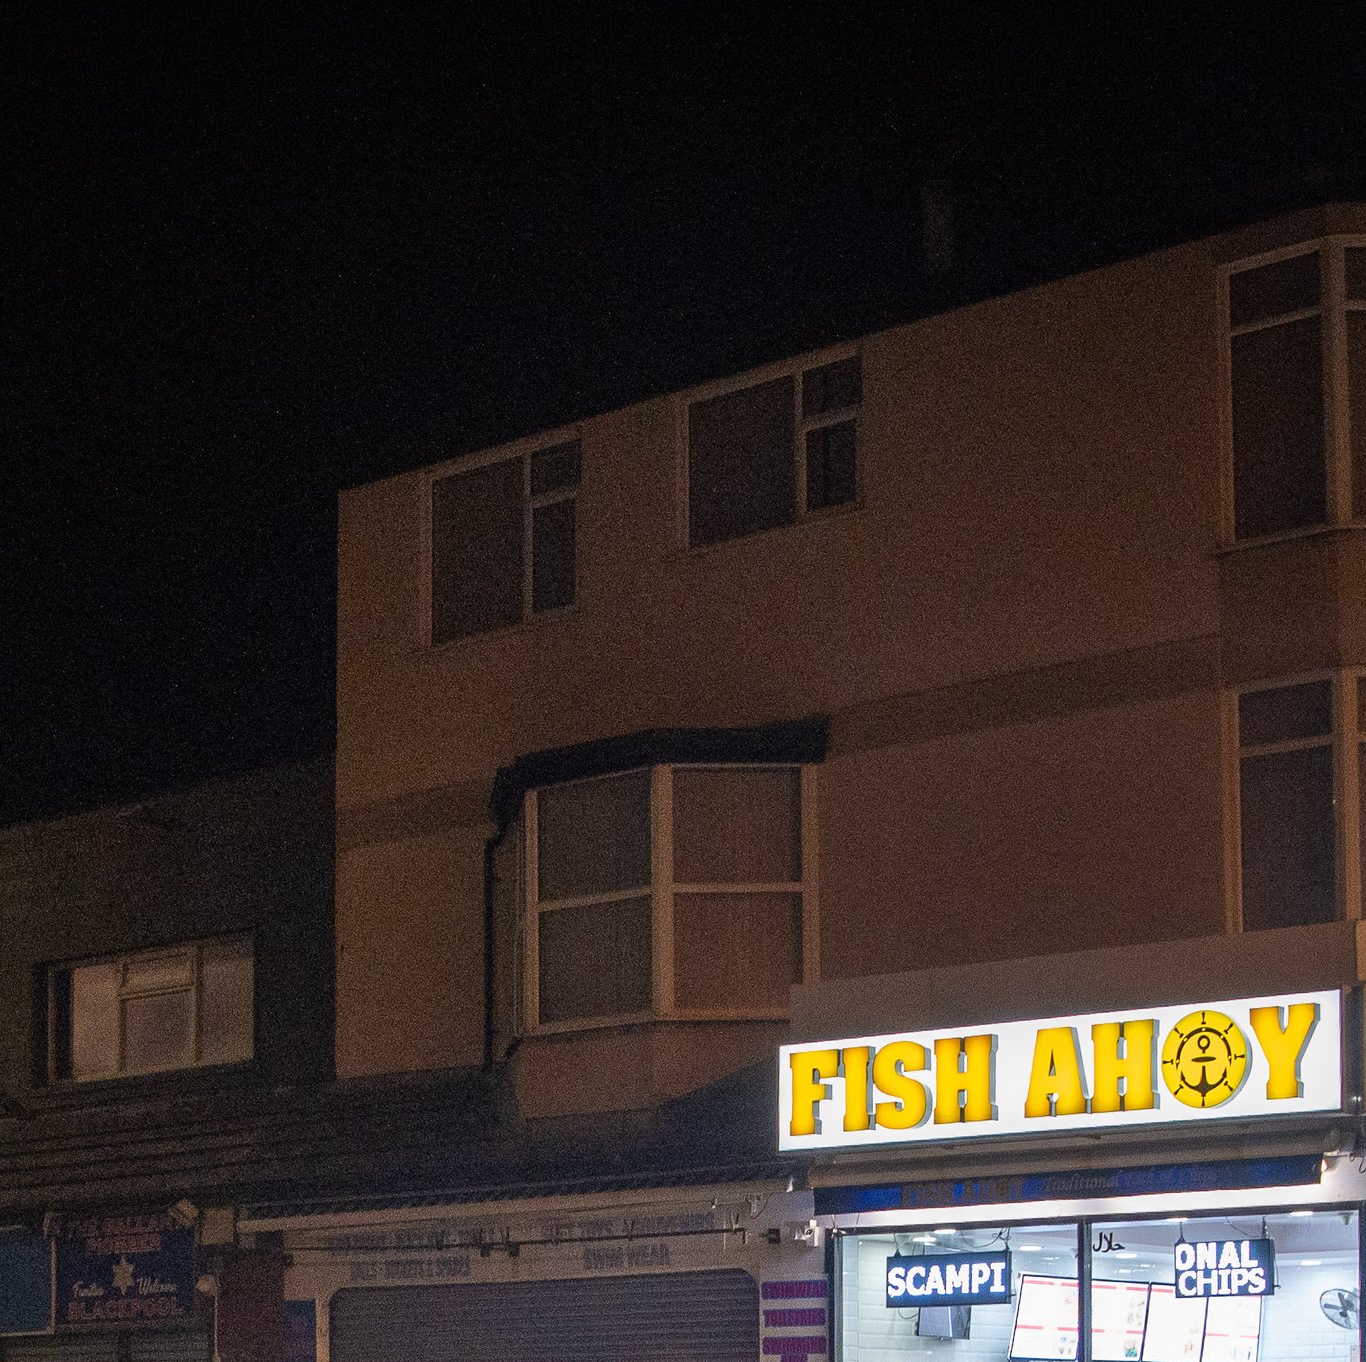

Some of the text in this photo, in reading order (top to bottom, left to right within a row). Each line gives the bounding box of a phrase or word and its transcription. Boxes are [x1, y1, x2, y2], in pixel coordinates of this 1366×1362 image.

[789, 1002, 1323, 1137] FISH AHOY
[1042, 1169, 1120, 1192] Traditional
[1092, 1232, 1126, 1253] حلال
[887, 1261, 1006, 1298] SCAMPI
[1178, 1267, 1267, 1297] CHIPS
